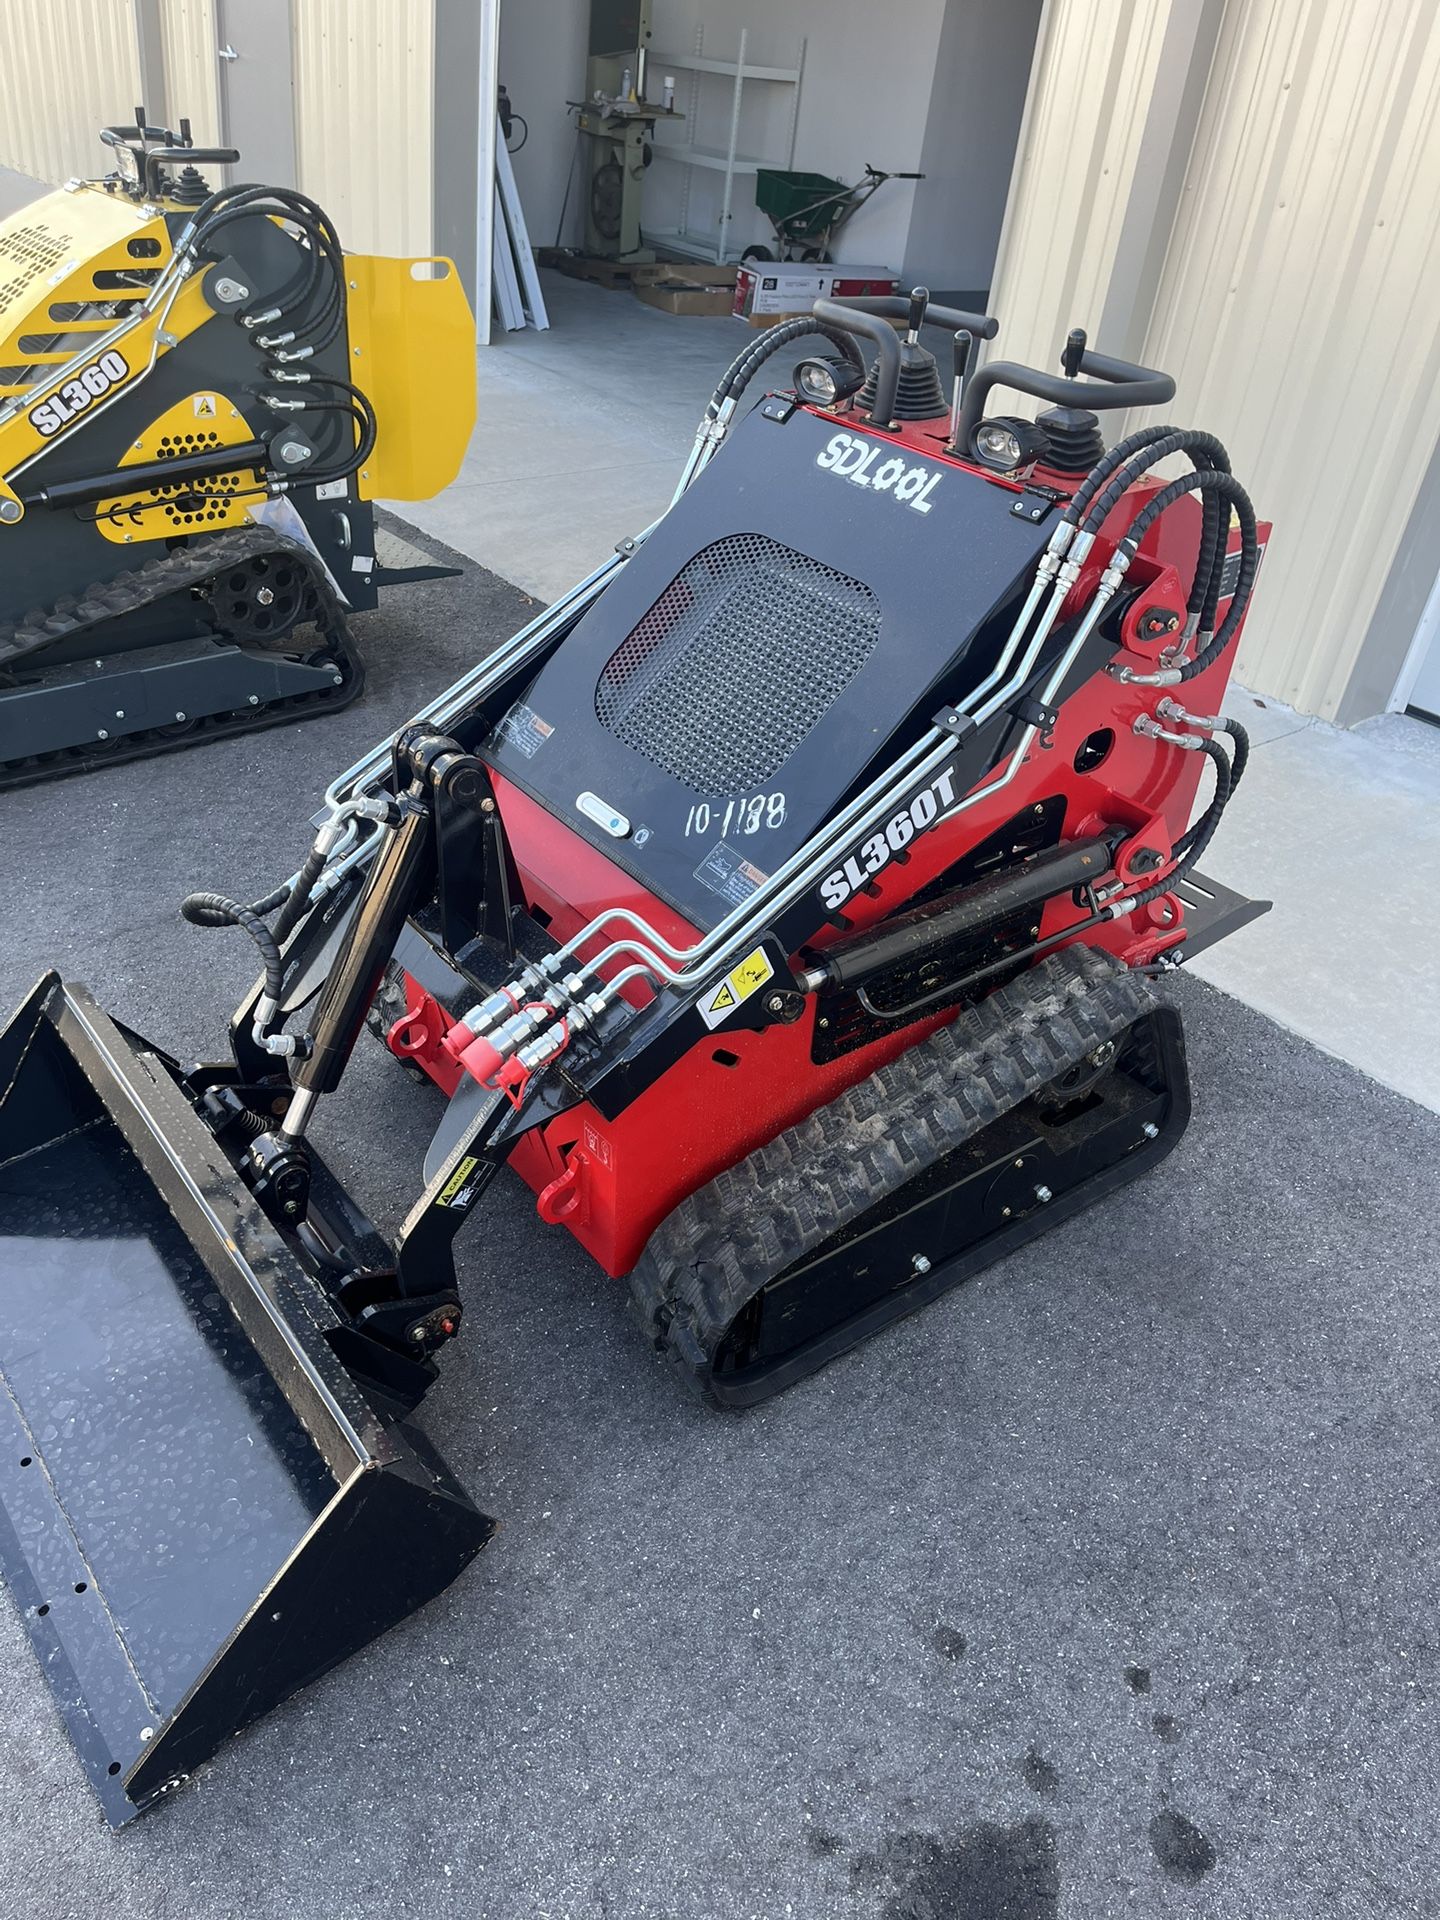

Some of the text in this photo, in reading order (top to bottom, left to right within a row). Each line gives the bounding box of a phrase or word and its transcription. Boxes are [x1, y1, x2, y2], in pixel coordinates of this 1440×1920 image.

[29, 350, 128, 436] SL360
[816, 433, 943, 514] SDLOOL
[819, 765, 956, 910] SL360T
[449, 1158, 474, 1191] CAUTION
